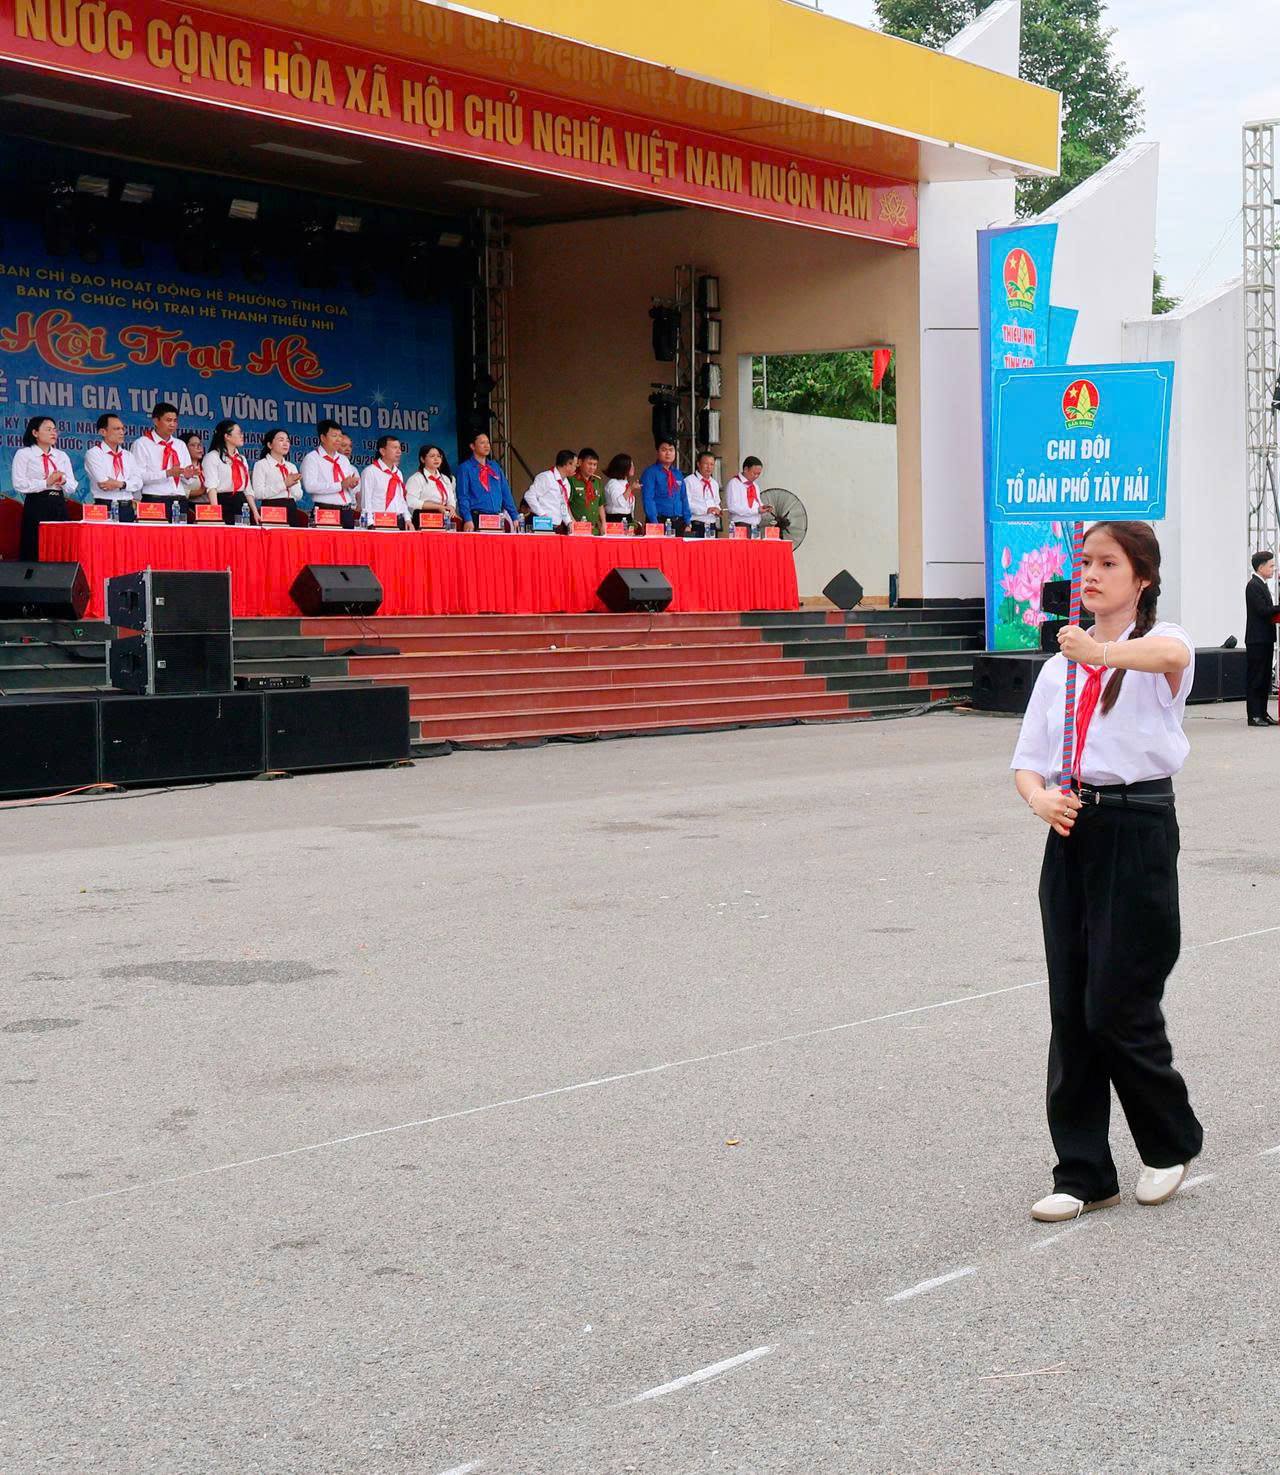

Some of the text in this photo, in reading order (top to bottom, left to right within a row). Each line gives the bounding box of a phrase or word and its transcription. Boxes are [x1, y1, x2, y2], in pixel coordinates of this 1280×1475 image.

[147, 15, 251, 88] CỘNG
[263, 41, 335, 105] HÒA
[345, 64, 392, 118] XÃ
[402, 75, 454, 136] HỘI
[464, 90, 524, 146] CHỦ
[532, 110, 617, 167] NGHĨA
[624, 131, 678, 183] VIỆT
[685, 146, 743, 194] NAM
[751, 161, 817, 209] MUÔN
[823, 175, 872, 221] NĂM
[16, 285, 50, 298] BAN
[80, 292, 128, 308] CHỨC
[132, 298, 159, 313] HỘI
[163, 302, 194, 317] TRẠI
[220, 308, 268, 323] THANH
[271, 313, 307, 328] THIẾU
[311, 320, 335, 331] NHI
[35, 268, 65, 282] CHỈ
[70, 273, 106, 288] ĐẠO
[111, 278, 152, 295] HOẠT
[156, 282, 202, 299] ĐỘNG
[324, 304, 349, 316] GIA
[0, 308, 352, 395] Hội Trại Hè
[16, 376, 74, 407] TĨNH
[81, 385, 122, 411] GIA
[128, 388, 158, 418] TỰ
[163, 387, 216, 420] HÀO,
[220, 393, 278, 422] VỮNG
[284, 400, 317, 424] TIN
[323, 403, 372, 428] THEO
[58, 420, 71, 432] 81
[1046, 434, 1111, 464] CHI ĐỘI
[1006, 466, 1149, 504] TỔ DÂN PHỐ TÂY HẢI
